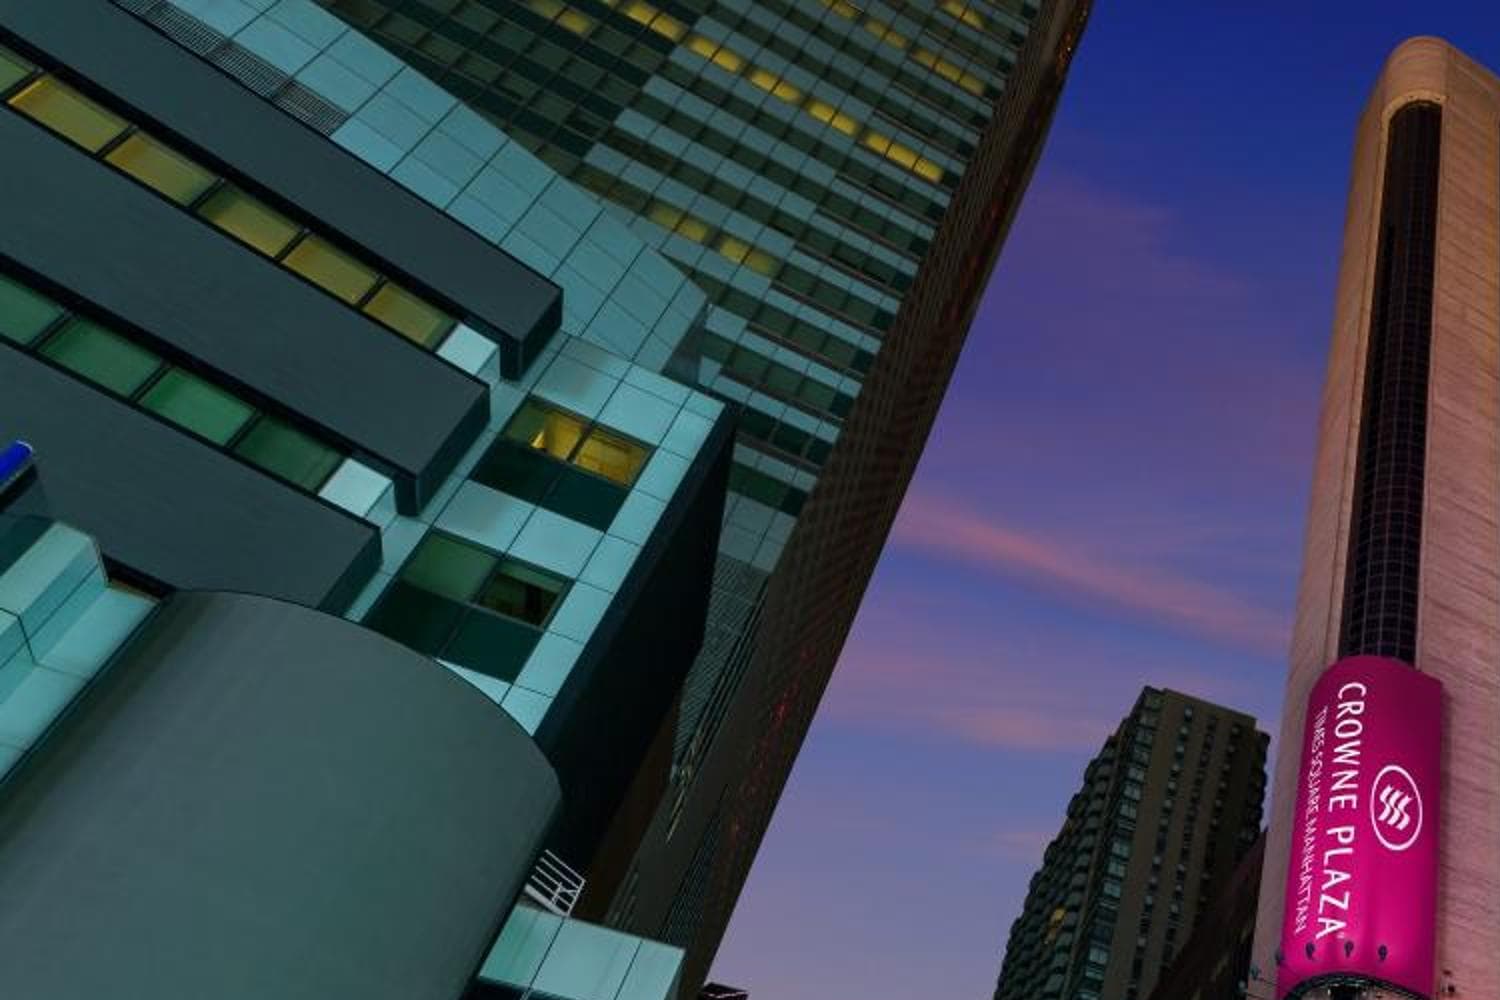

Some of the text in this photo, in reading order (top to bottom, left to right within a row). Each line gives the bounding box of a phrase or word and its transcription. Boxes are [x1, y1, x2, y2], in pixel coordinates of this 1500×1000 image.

[1295, 706, 1328, 935] TIMES SQUARE MANHATTAN
[1315, 682, 1367, 940] CROWNE PLAZA
